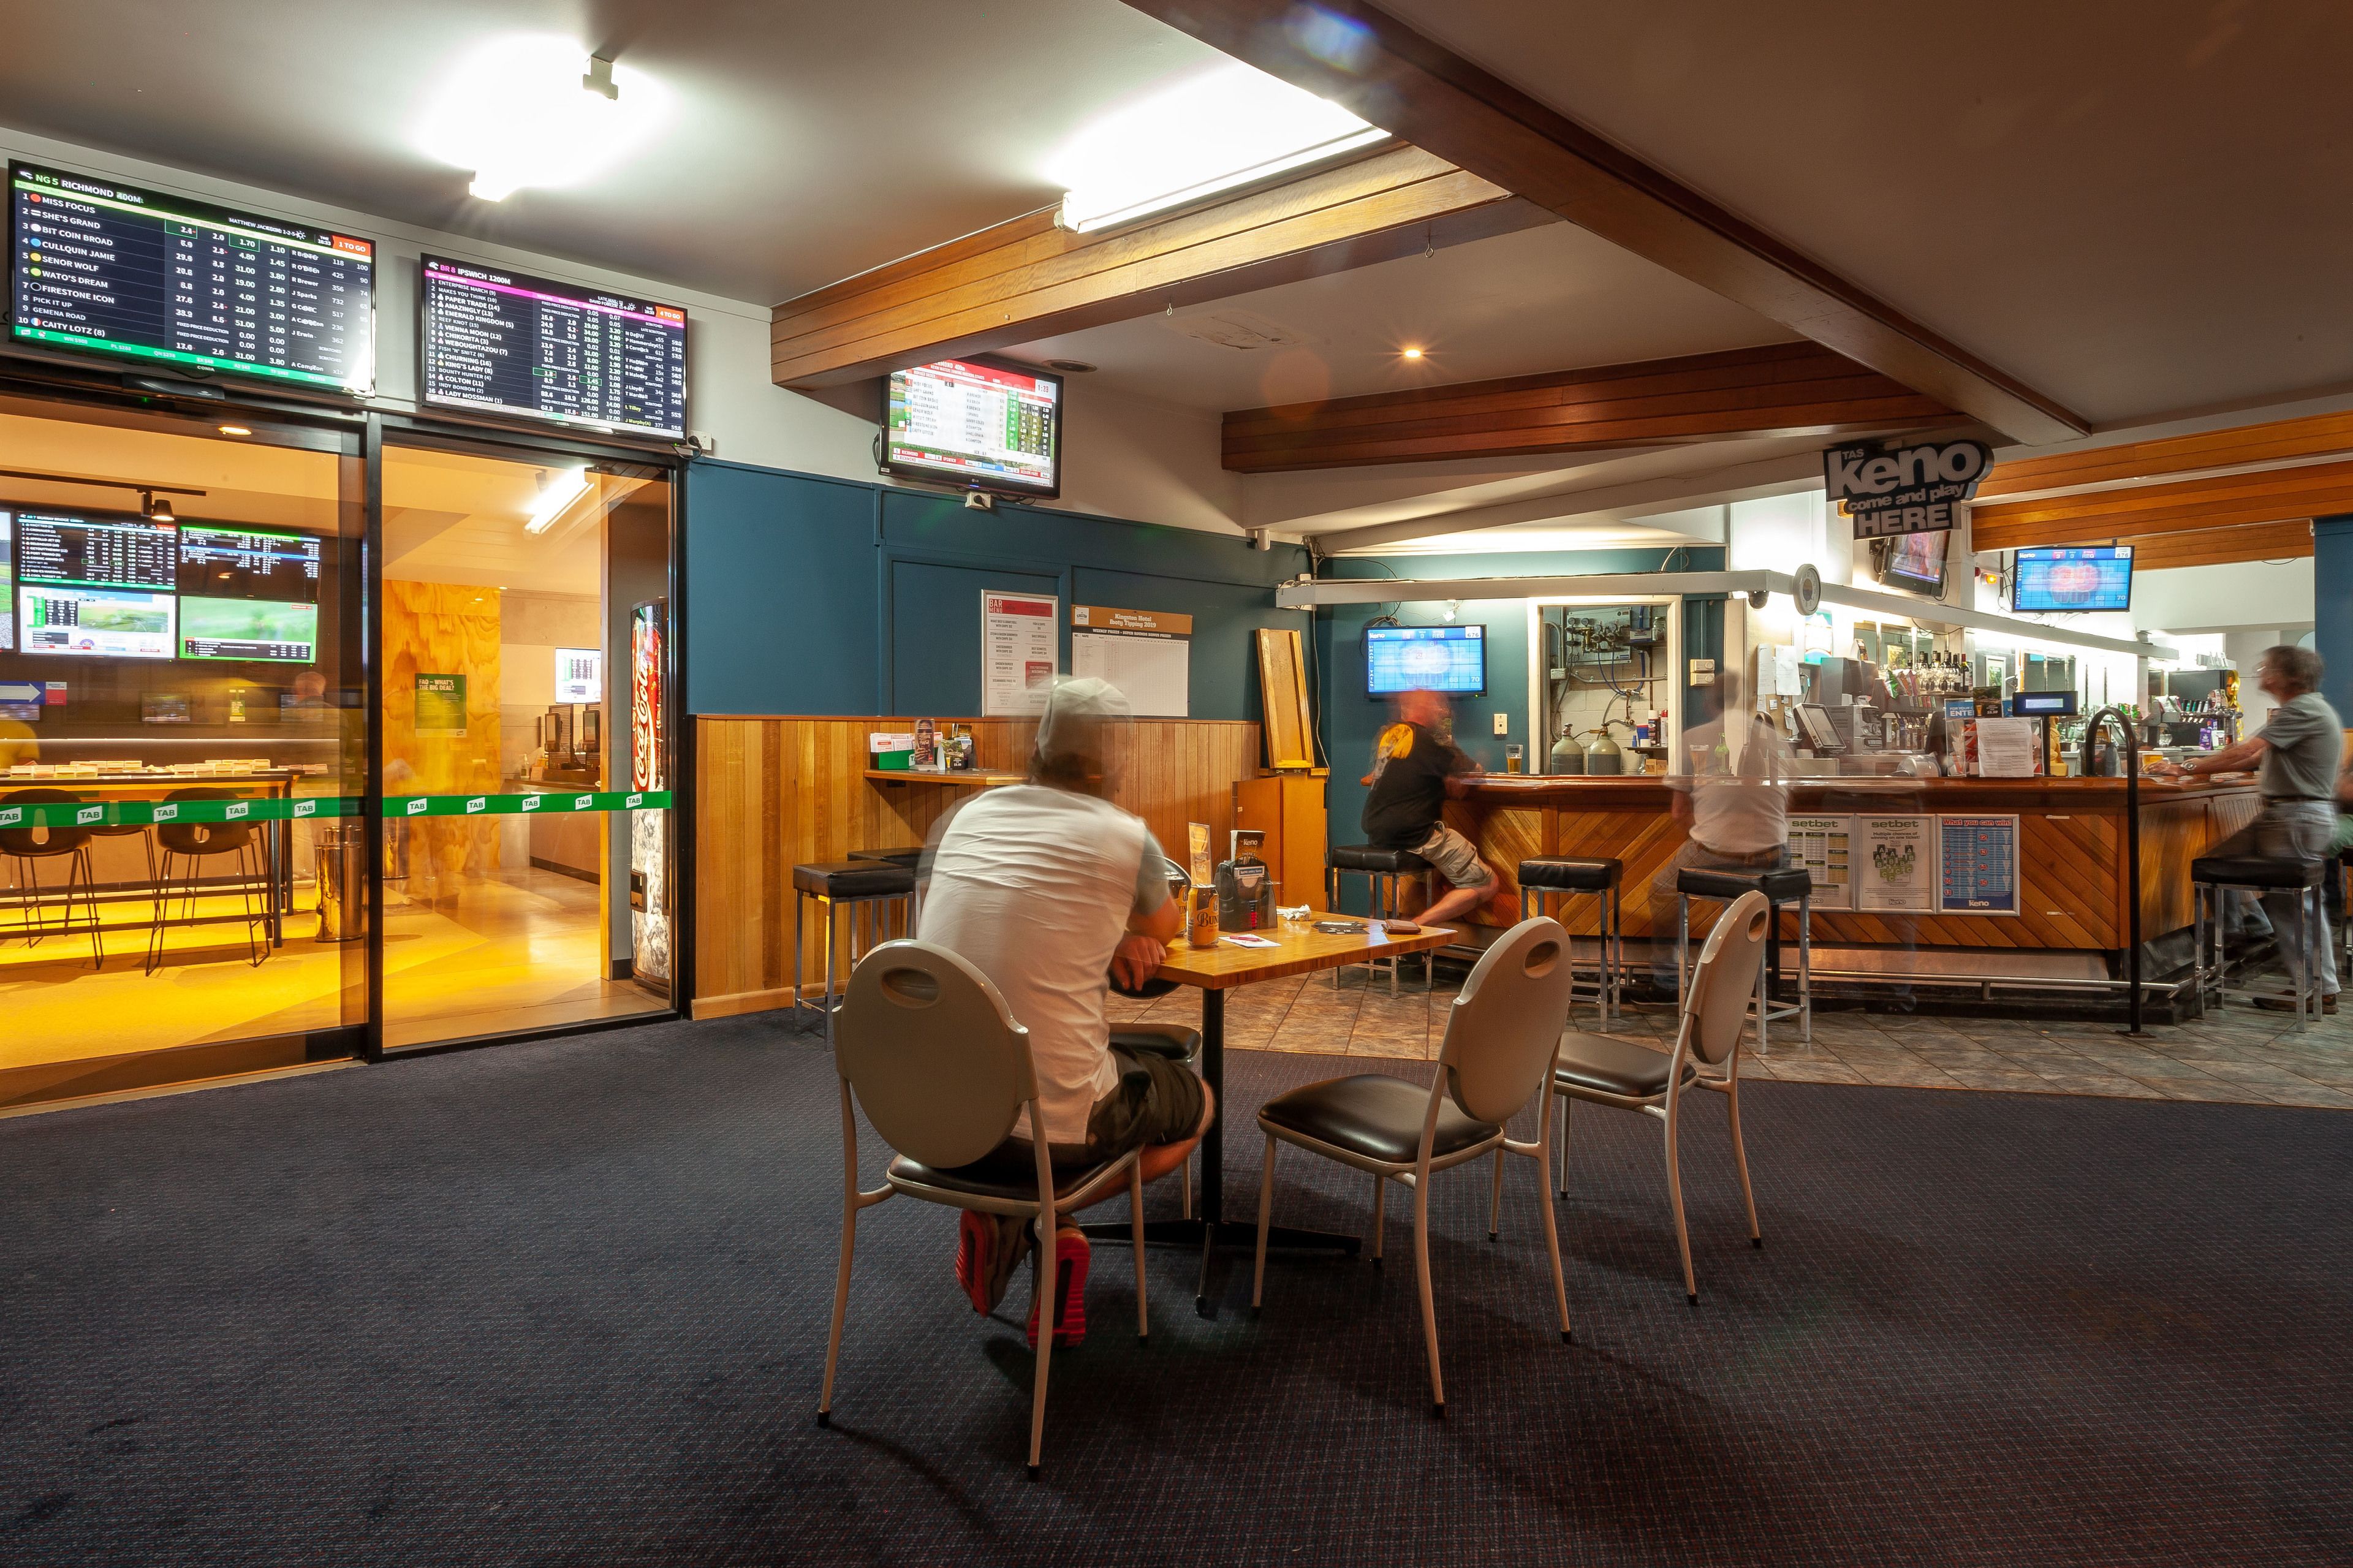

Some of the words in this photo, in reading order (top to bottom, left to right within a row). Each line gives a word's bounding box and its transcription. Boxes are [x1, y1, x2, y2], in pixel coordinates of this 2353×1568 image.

[36, 174, 50, 184] NG
[62, 180, 114, 197] RICHMOND
[42, 197, 64, 207] MISS
[66, 199, 96, 214] FOCUS
[42, 211, 69, 223] SHE'S
[70, 218, 100, 229] GRAND
[42, 227, 58, 235] BIT
[59, 230, 81, 240] COIN
[83, 233, 113, 246] BROAD
[42, 241, 87, 256] CULLQUIN
[89, 251, 115, 261] JAMIE
[42, 256, 72, 268] SENOR
[74, 261, 99, 272] WOLF
[42, 270, 77, 283] WATO'S
[78, 277, 108, 288] DREAM
[458, 268, 487, 280] IPSWICH
[489, 275, 511, 285] 1200M
[33, 296, 50, 305] PICK
[42, 286, 91, 300] FIRESTONE
[93, 294, 115, 304] ICON
[445, 295, 466, 304] PAPER
[467, 300, 488, 309] TRADE
[33, 308, 64, 317] GEMENA
[66, 312, 86, 321] ROAD
[445, 303, 480, 314] AMAZINGLY
[445, 310, 474, 320] EMERALD
[476, 316, 505, 327] KINGDOM
[42, 320, 67, 331] CAITY
[70, 325, 92, 335] LOTZ
[94, 328, 105, 337] (8)
[445, 325, 469, 335] VIENNA
[445, 332, 480, 343] CHIKORITA
[445, 339, 499, 353] WEBOUGHTAZOU
[445, 354, 479, 364] CHURNING
[445, 376, 471, 385] COLTON
[462, 393, 493, 403] MOSSMAN
[1842, 449, 1865, 460] TAS
[1827, 442, 1982, 498] keno
[1848, 494, 1892, 512] come
[1895, 488, 1926, 506] and
[1930, 483, 1966, 502] play
[1857, 503, 1950, 537] HERE
[989, 599, 1002, 608] BAR
